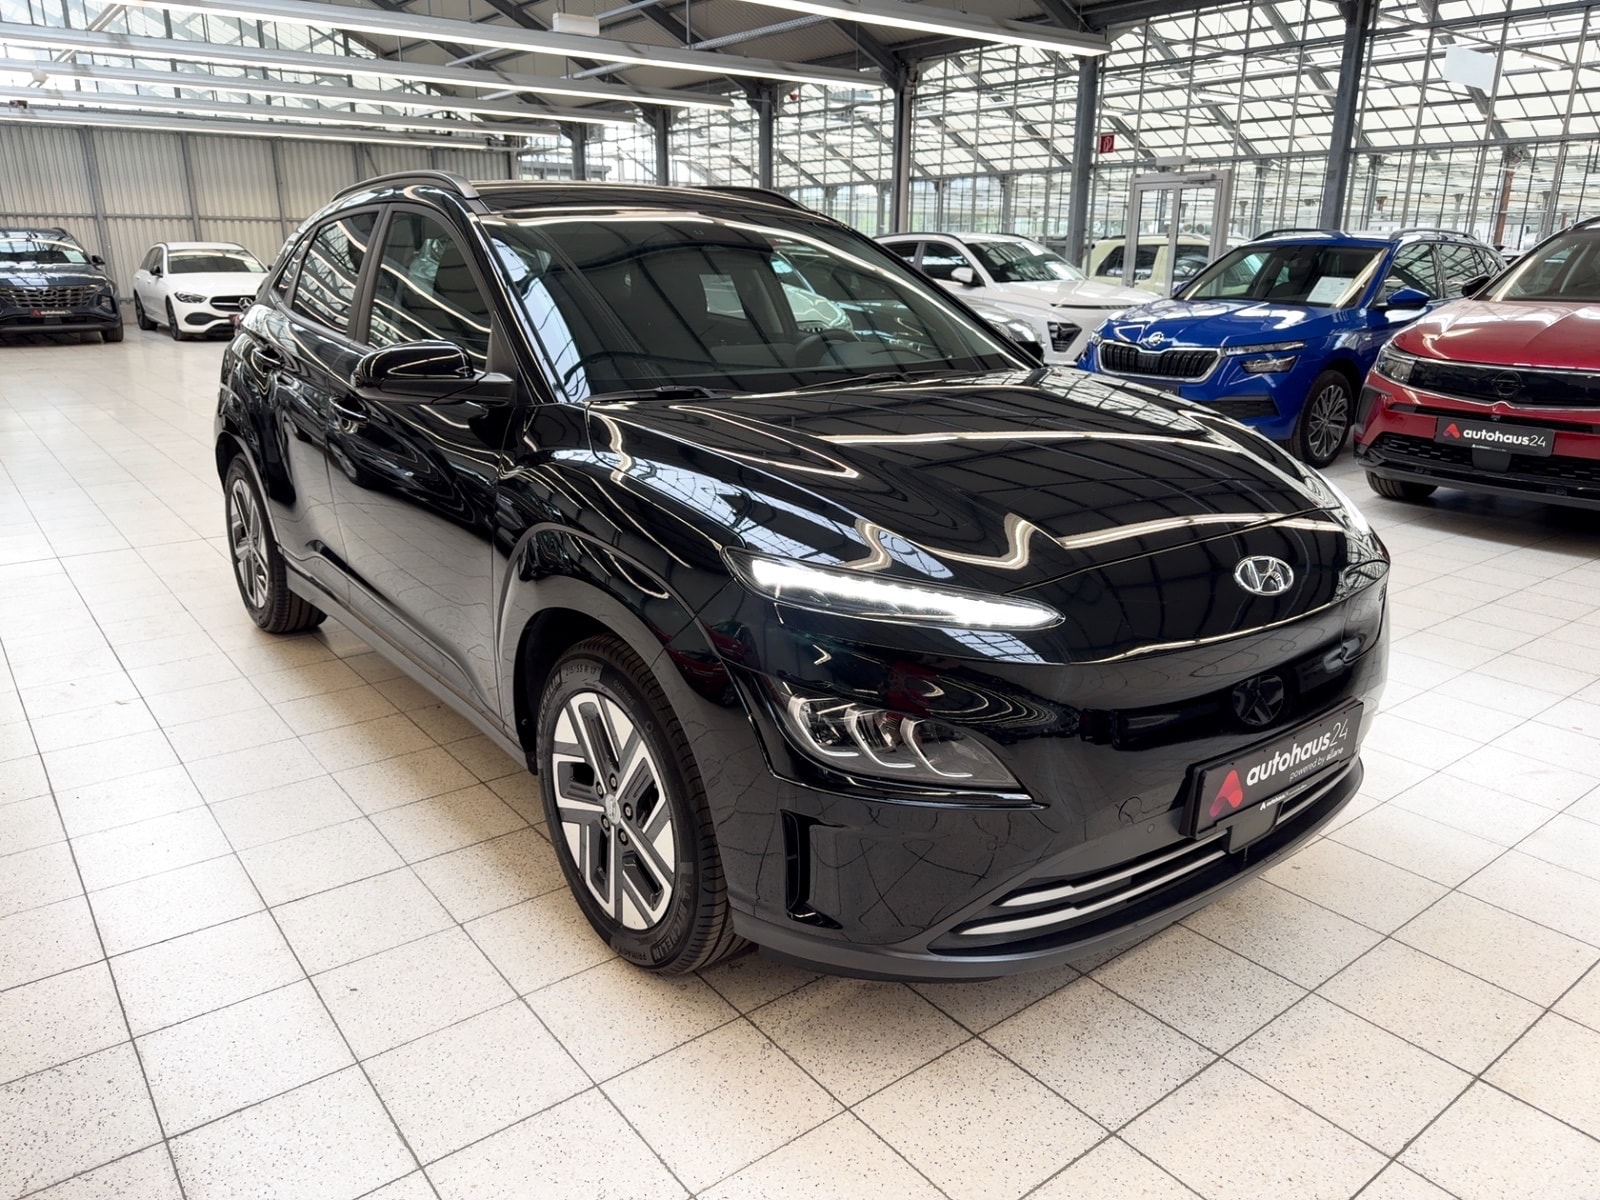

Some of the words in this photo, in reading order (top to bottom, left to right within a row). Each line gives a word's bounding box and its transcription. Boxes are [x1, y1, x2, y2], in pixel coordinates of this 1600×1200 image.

[1463, 429, 1546, 447] autohaus24
[1246, 718, 1349, 786] autohaus24
[1289, 758, 1318, 783] powered
[652, 902, 688, 960] MICHELIN
